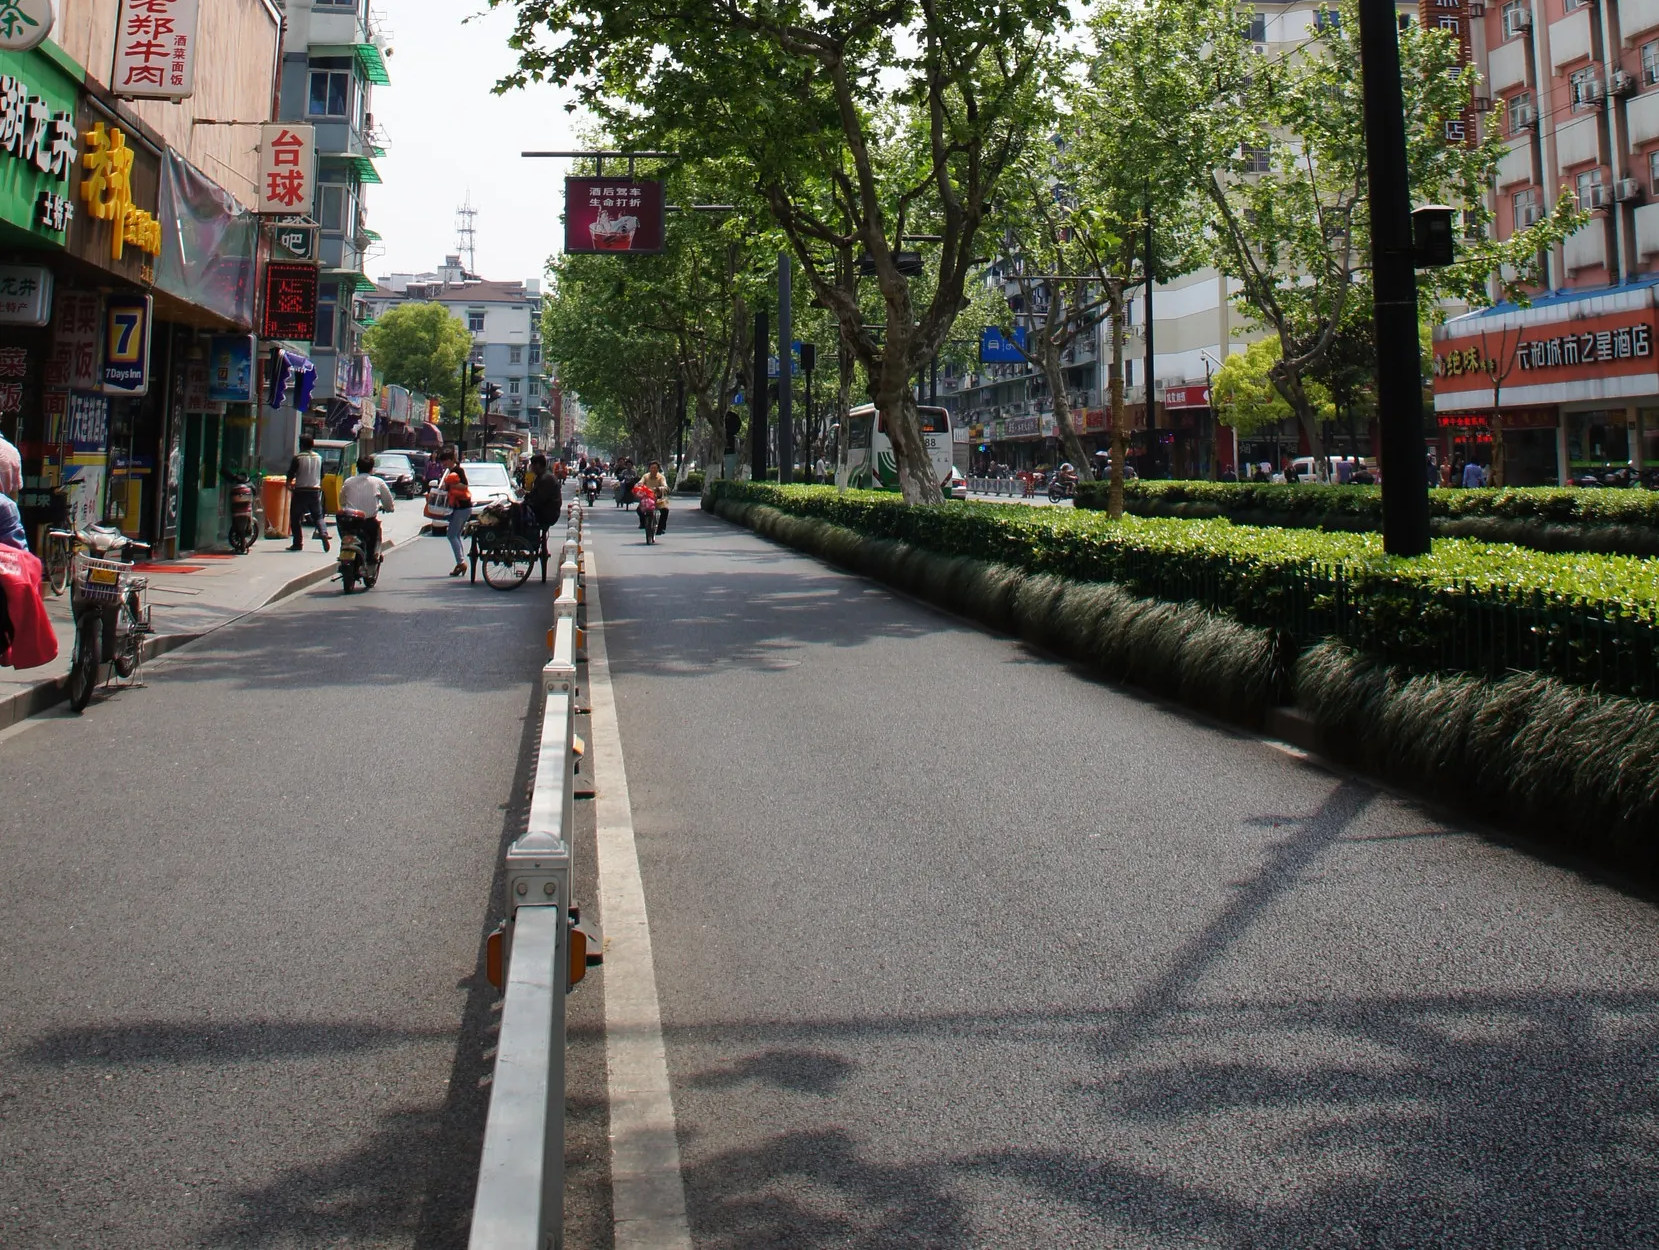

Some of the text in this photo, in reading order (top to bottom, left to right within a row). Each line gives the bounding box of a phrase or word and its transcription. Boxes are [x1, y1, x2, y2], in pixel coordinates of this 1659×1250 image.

[170, 35, 188, 87] 酒菜面饭
[266, 129, 305, 207] 台球
[589, 187, 642, 197] 酒后驾车
[589, 198, 642, 207] 生命打折
[114, 312, 140, 356] 7
[129, 368, 142, 379] Inn
